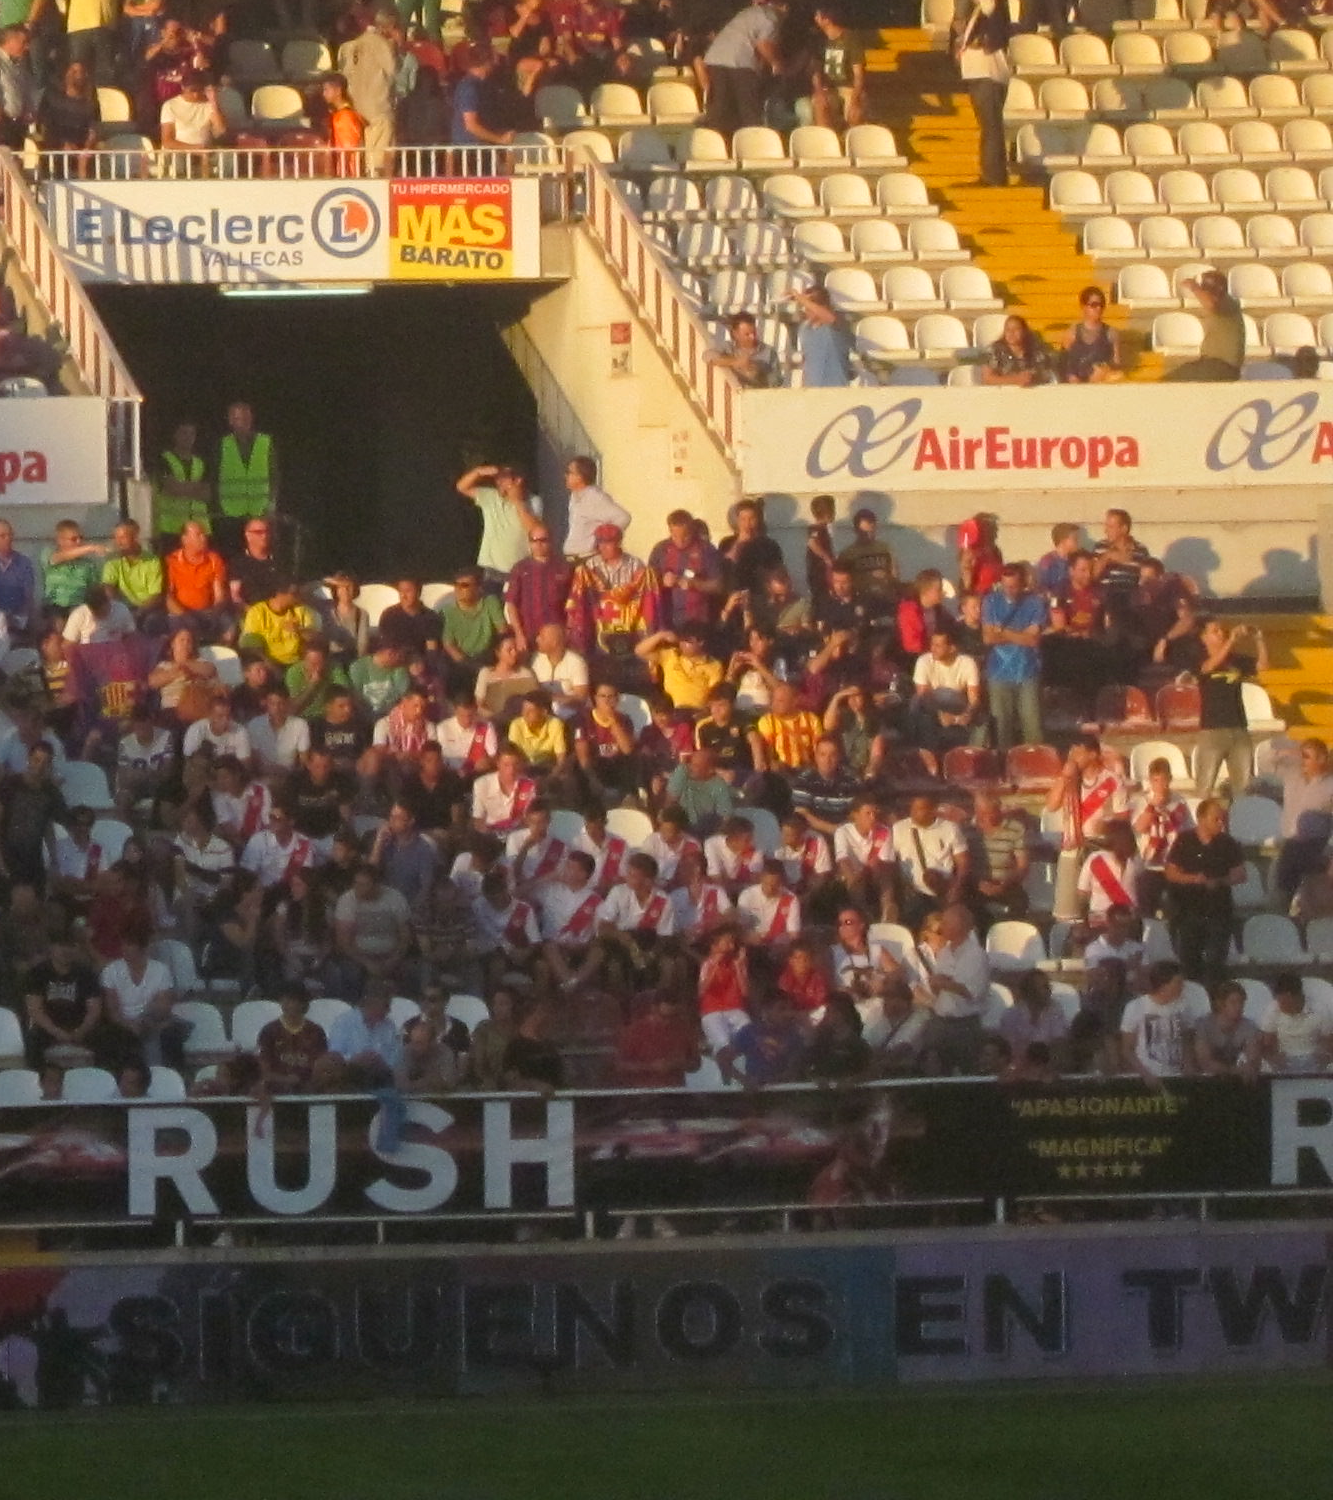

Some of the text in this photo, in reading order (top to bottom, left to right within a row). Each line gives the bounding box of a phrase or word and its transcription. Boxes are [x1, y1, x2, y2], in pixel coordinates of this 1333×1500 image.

[391, 184, 510, 195] TU HIPERMERCADO
[397, 200, 506, 245] MÁS
[202, 251, 303, 268] VALLECAS
[400, 245, 504, 270] BARATO
[913, 426, 1140, 478] AirEuropa
[128, 1100, 575, 1216] RUSH
[895, 1270, 1067, 1354] EN
